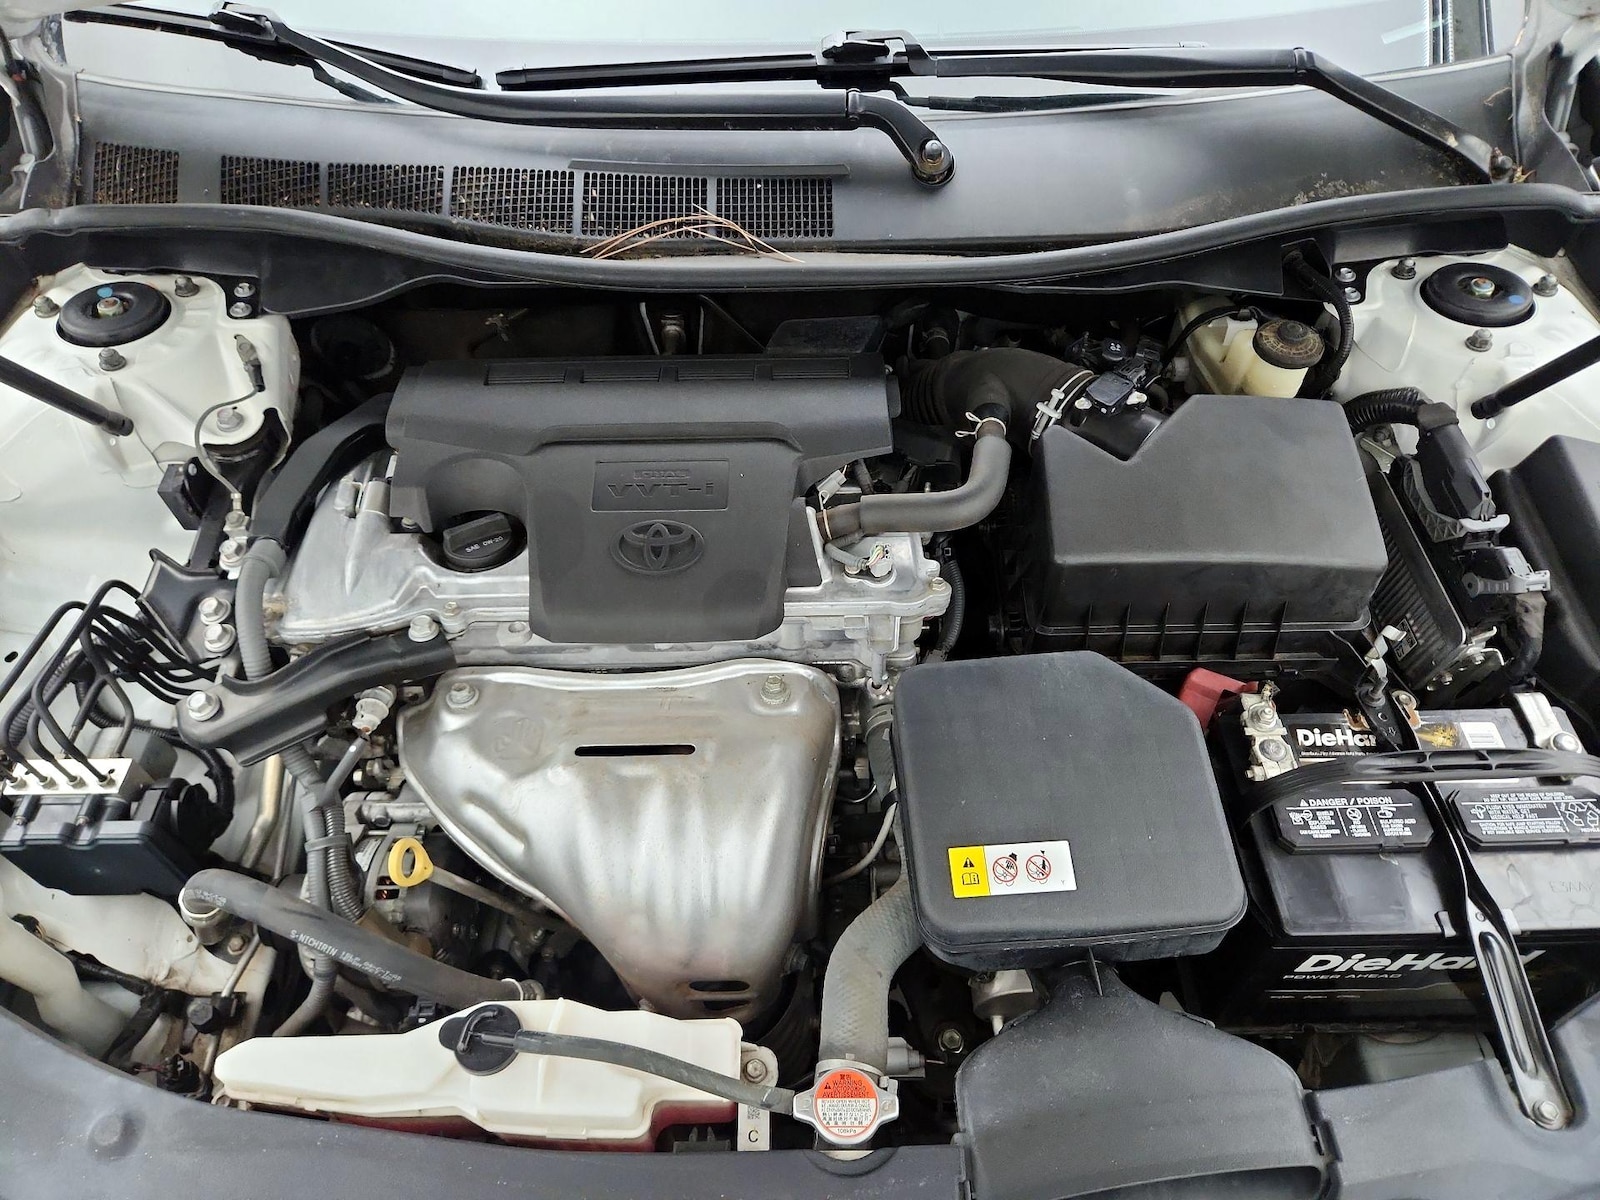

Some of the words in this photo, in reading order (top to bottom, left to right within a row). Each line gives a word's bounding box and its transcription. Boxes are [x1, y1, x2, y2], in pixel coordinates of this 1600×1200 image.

[608, 482, 714, 498] VVT-i
[465, 543, 480, 553] SAE
[482, 536, 504, 546] 0W-20
[1296, 727, 1377, 747] DieHar
[1308, 798, 1348, 806] DANGER
[1356, 796, 1393, 805] POISON
[748, 1129, 759, 1143] C
